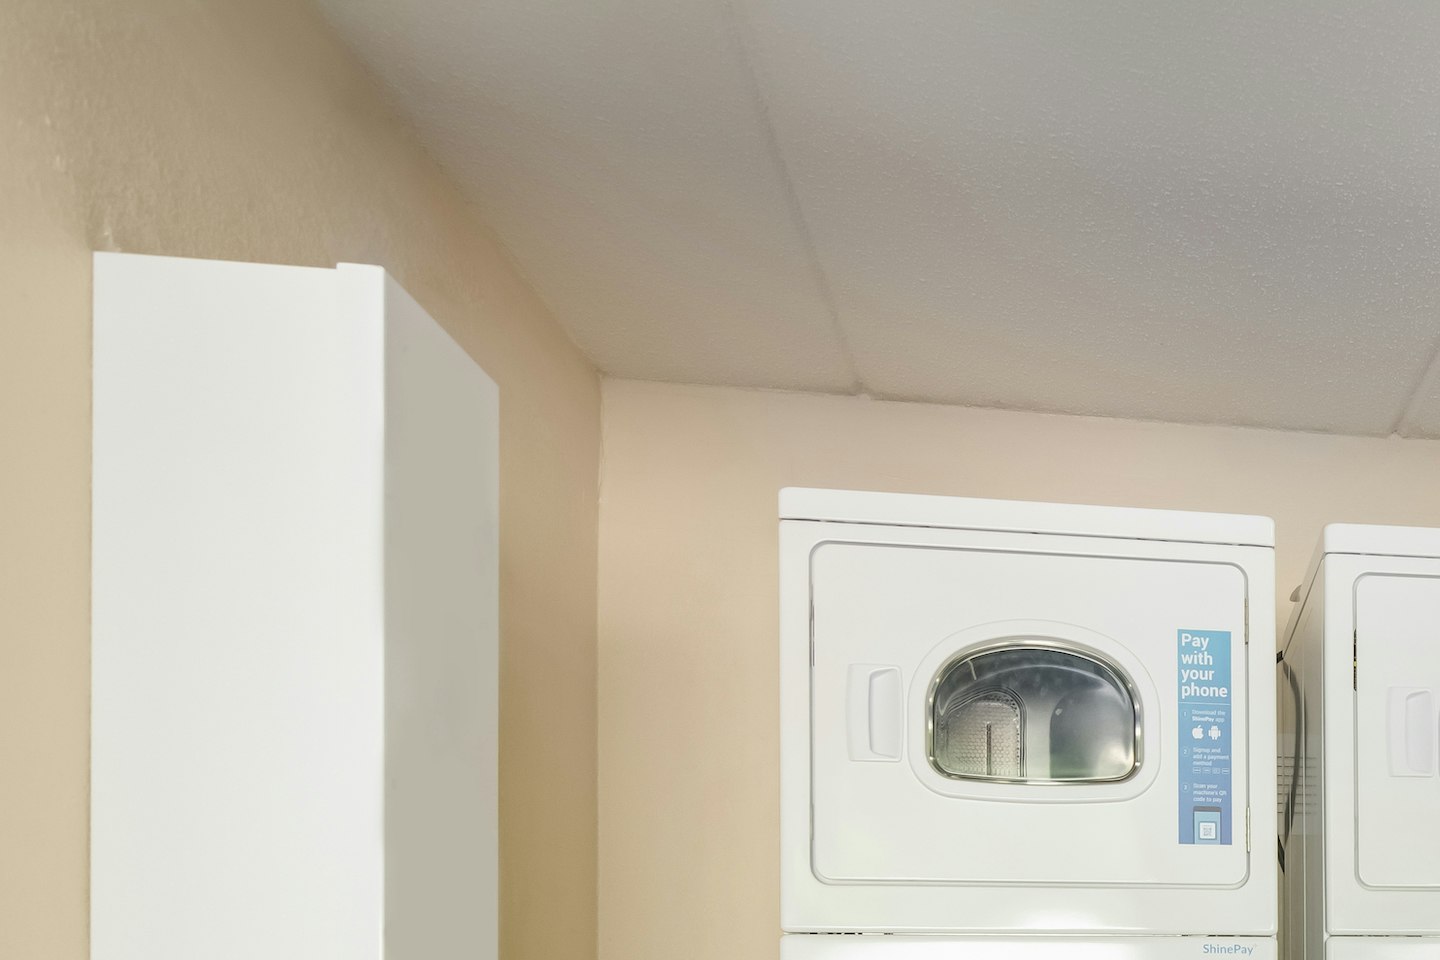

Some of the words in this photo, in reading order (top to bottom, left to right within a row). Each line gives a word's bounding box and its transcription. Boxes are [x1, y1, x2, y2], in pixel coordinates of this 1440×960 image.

[1181, 633, 1209, 651] Pay
[1181, 650, 1213, 665] with
[1181, 669, 1215, 683] your
[1181, 682, 1228, 699] phone
[1203, 944, 1254, 957] ShinePay
